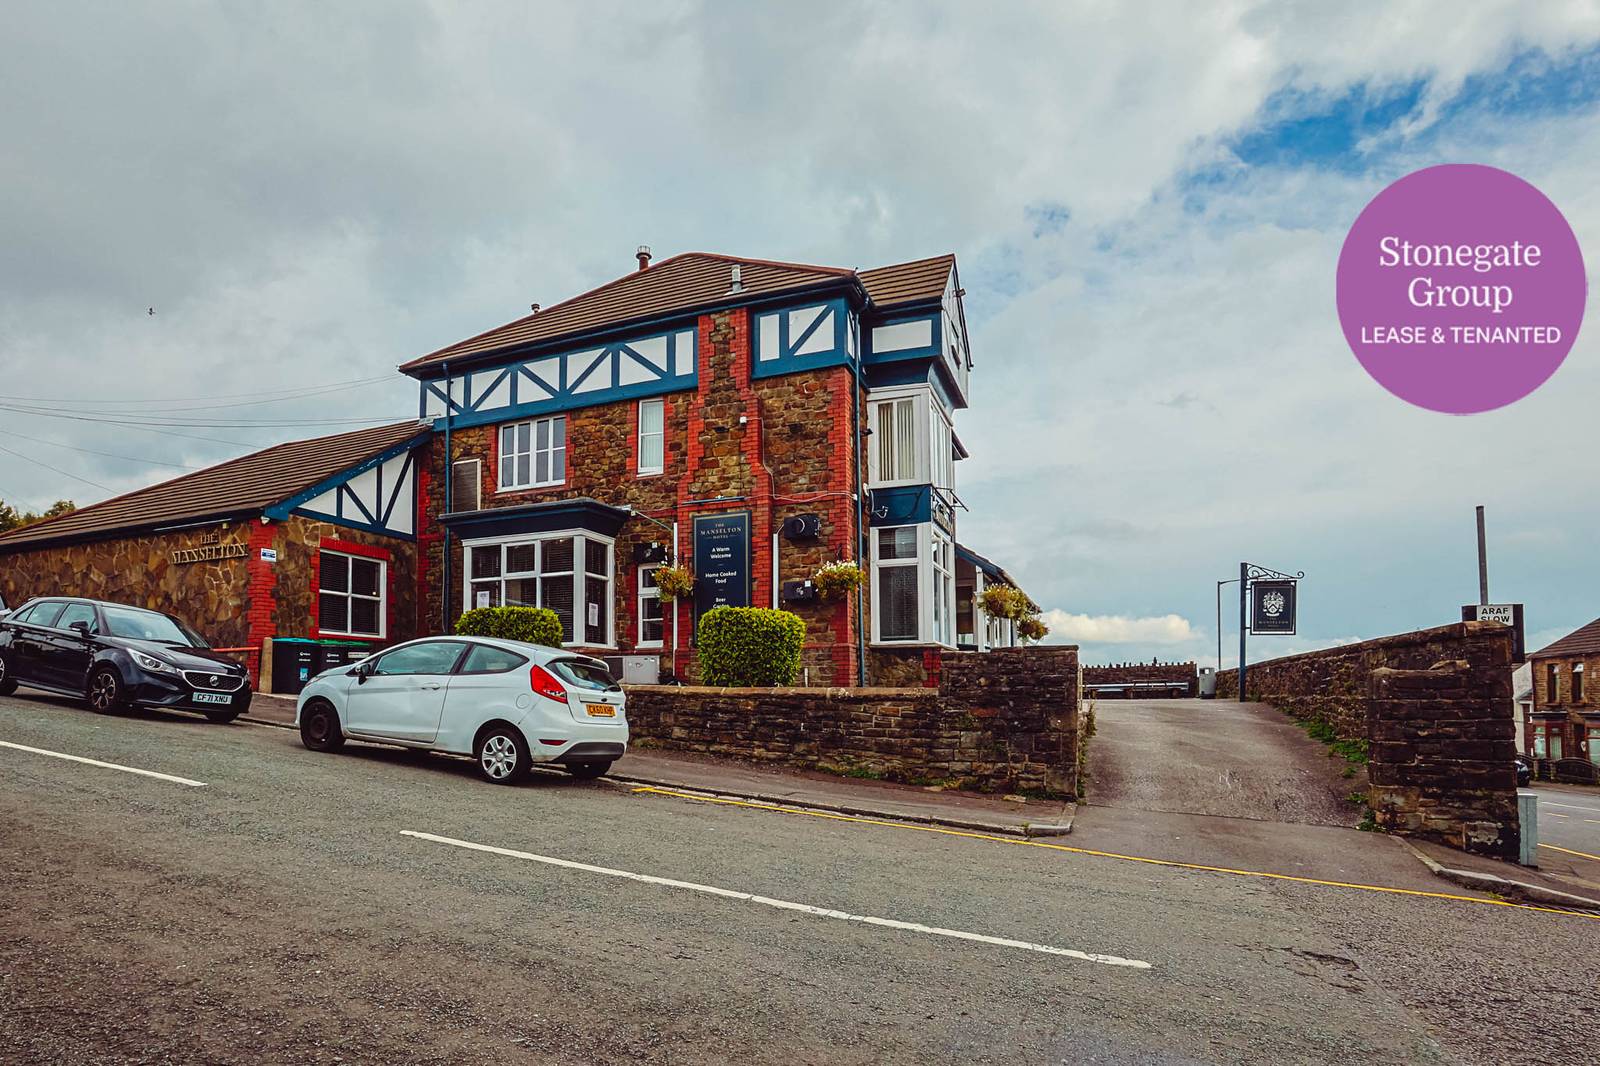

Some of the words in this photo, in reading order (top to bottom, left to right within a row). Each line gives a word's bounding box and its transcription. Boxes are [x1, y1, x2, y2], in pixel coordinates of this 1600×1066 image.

[700, 527, 742, 535] MANSELTON
[171, 543, 249, 564] MANSELTON
[1481, 607, 1509, 615] ARAF
